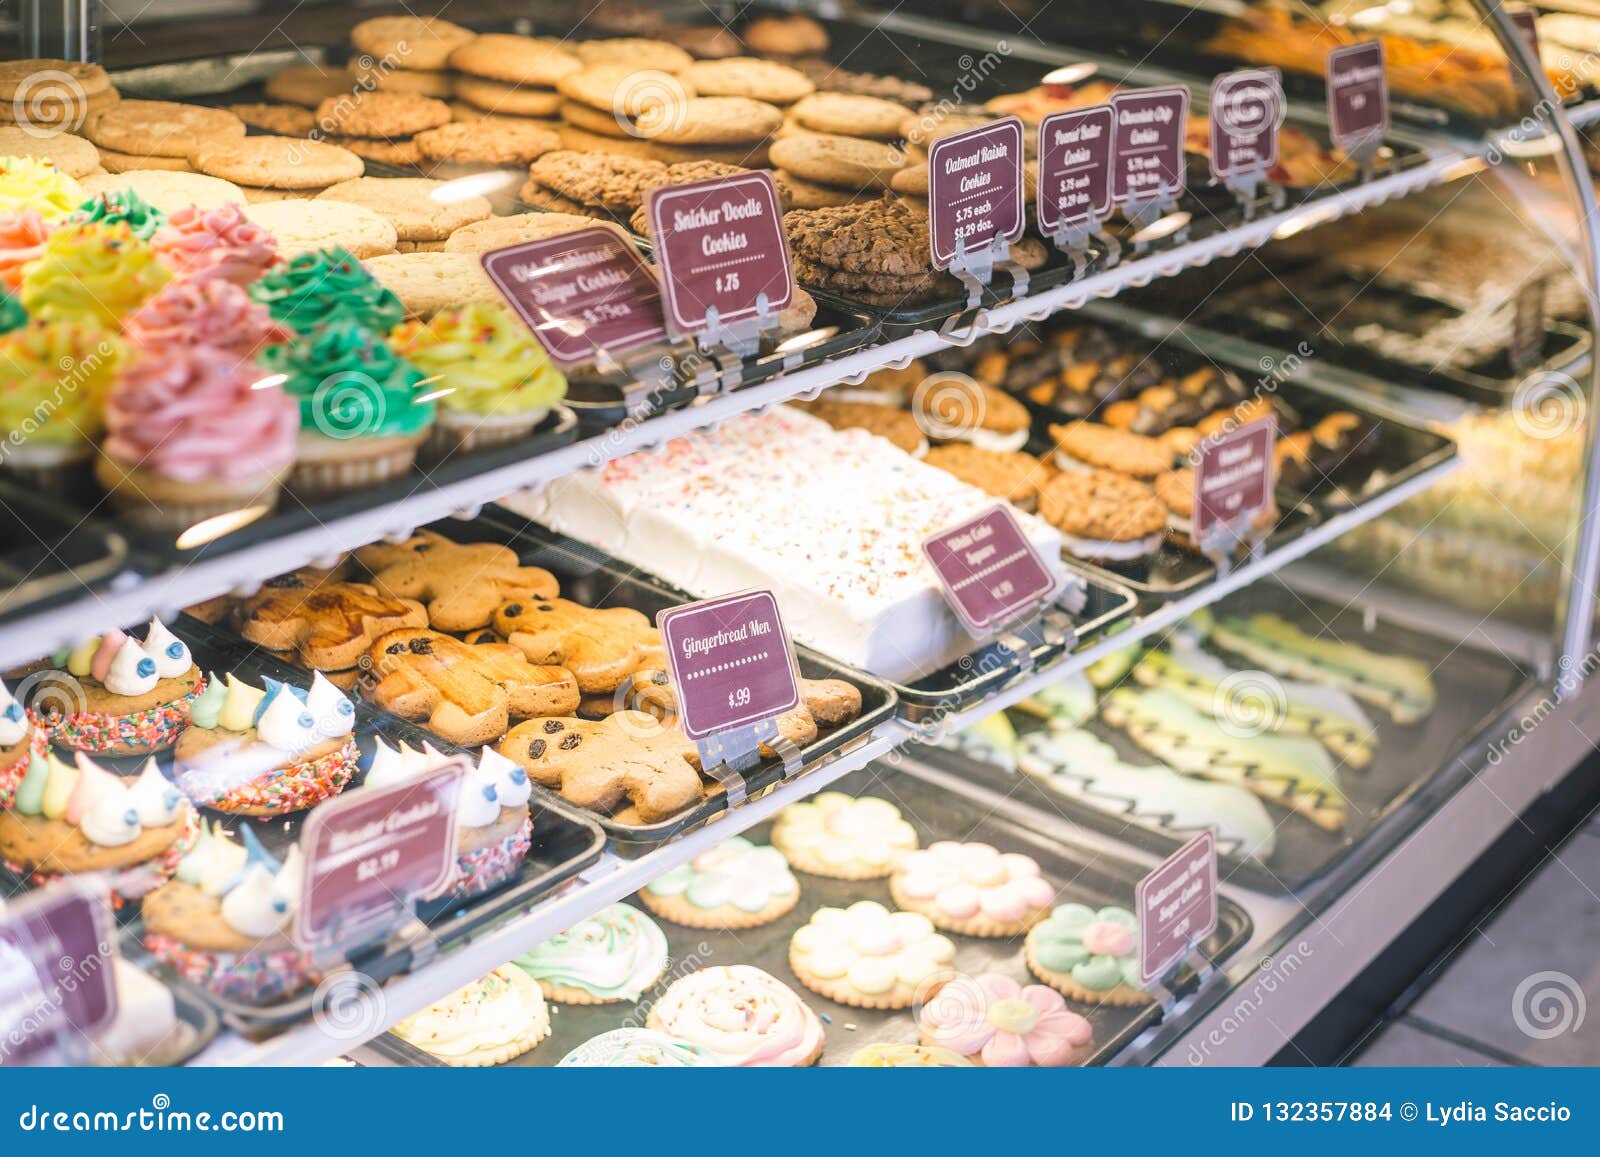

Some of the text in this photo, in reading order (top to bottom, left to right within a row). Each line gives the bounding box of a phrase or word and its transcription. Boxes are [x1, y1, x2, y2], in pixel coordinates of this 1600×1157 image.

[1055, 124, 1102, 145] Peanut Butter
[945, 143, 1007, 174] Oatmeal Raisin
[960, 172, 991, 193] Cookies
[1075, 174, 1090, 188] each
[674, 198, 762, 232] Snicker Doodle
[956, 200, 991, 222] $.75 each
[954, 220, 993, 240] $8.29 doz.
[702, 231, 748, 256] Cookies
[531, 268, 630, 304] Sugar Cookies
[683, 620, 771, 659] Gingerbread Men
[728, 687, 751, 708] $.99
